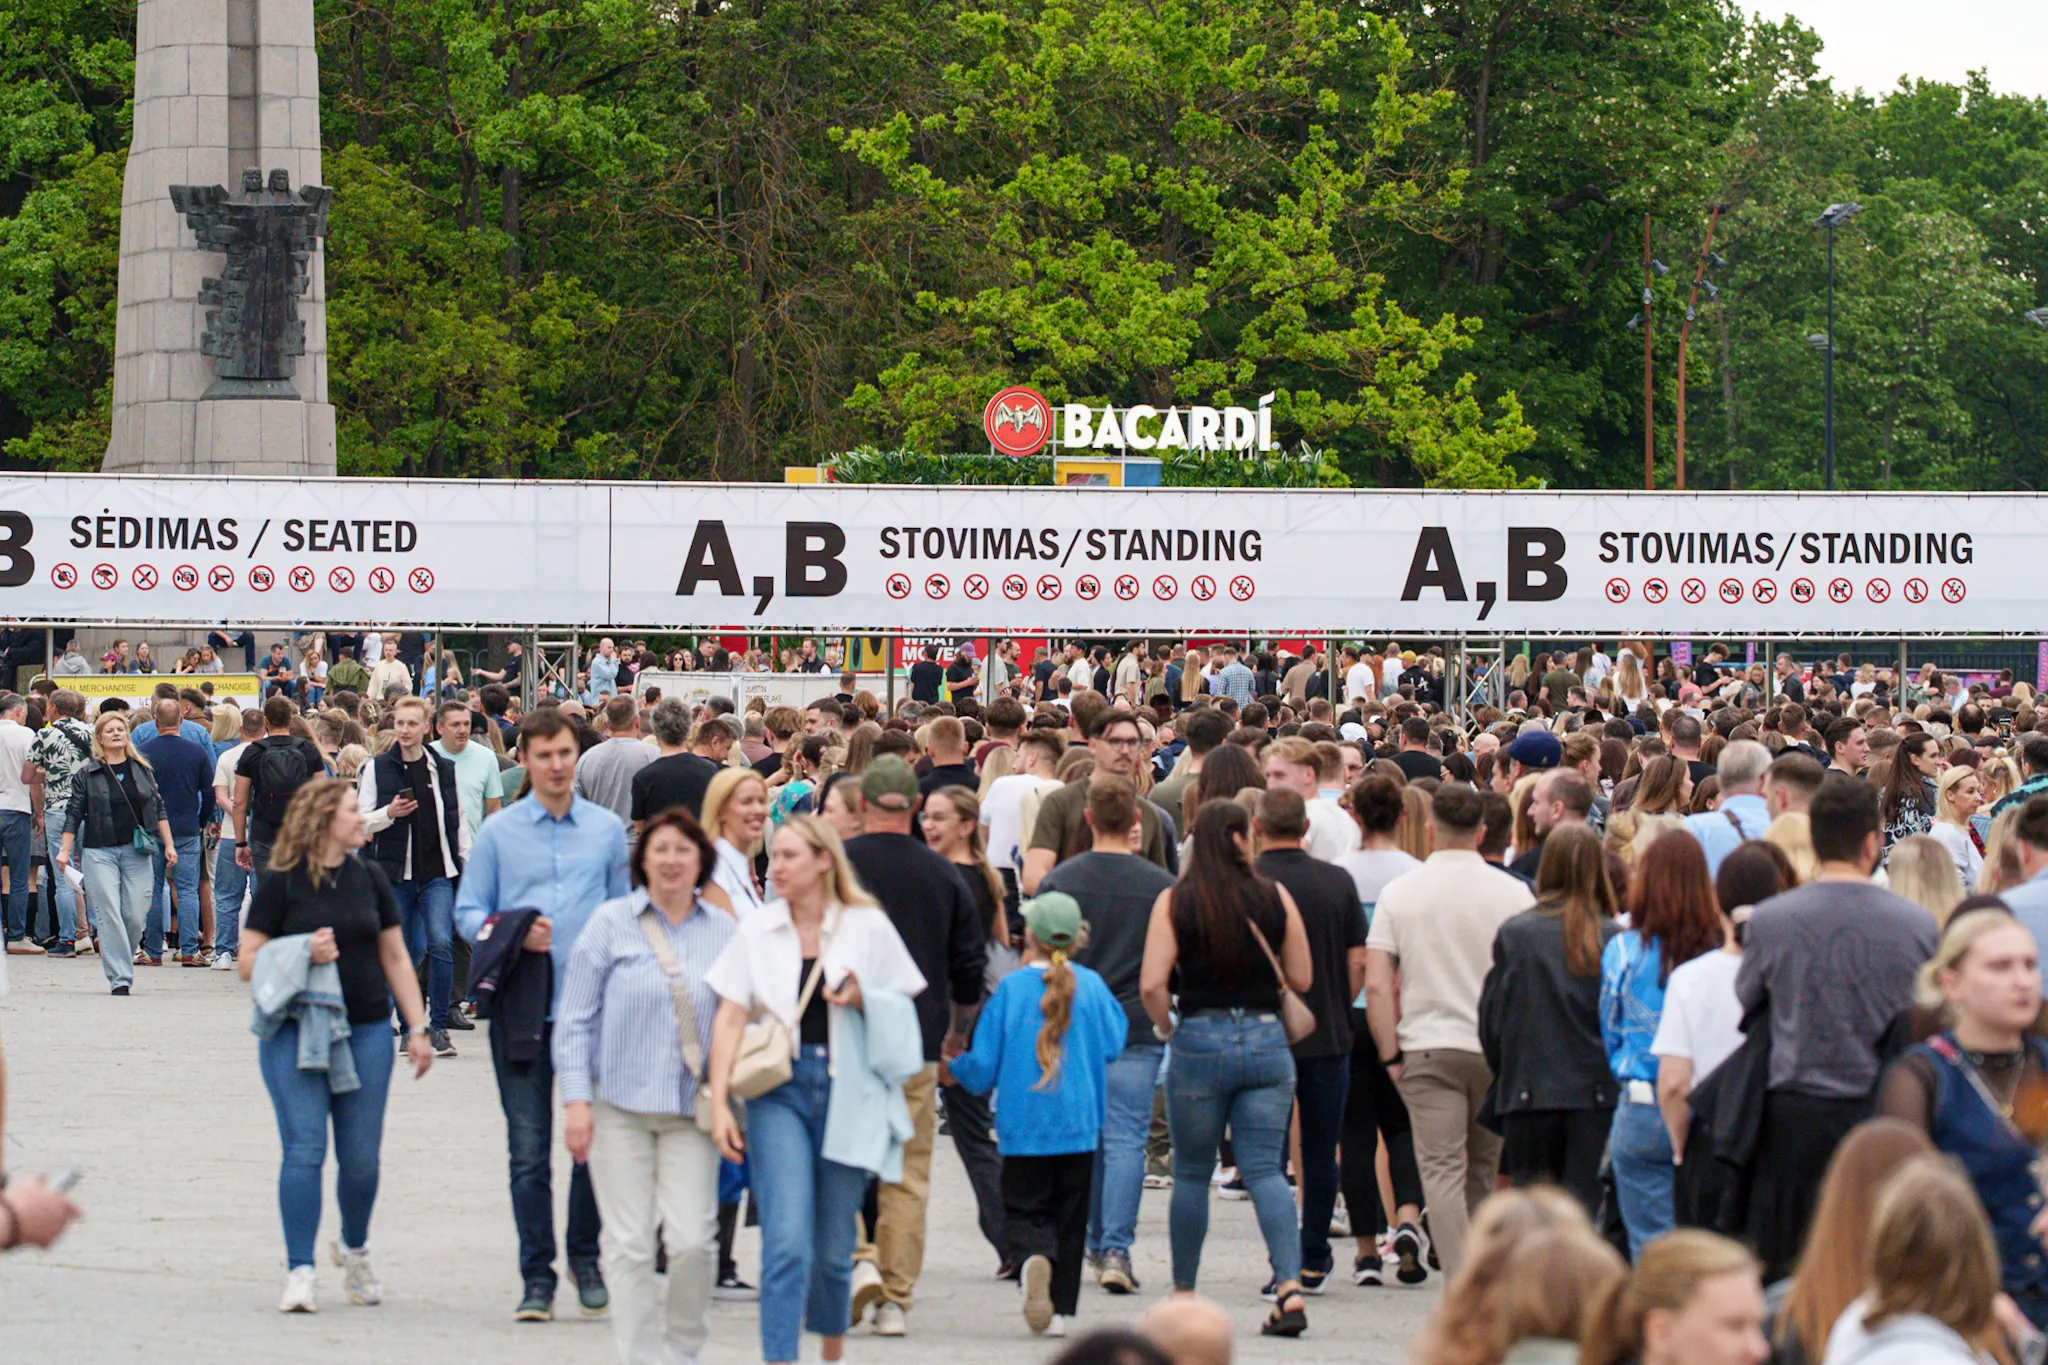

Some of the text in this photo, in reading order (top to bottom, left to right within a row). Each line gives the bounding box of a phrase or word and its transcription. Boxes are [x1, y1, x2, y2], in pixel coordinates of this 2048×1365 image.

[1064, 391, 1275, 451] BACARDÍ
[70, 508, 239, 551] SĖDIMAS
[282, 519, 417, 553] SEATED
[879, 526, 1262, 568] STOVIMAS/STANDING
[1599, 532, 1973, 572] STOVIMAS/STANDING
[675, 519, 848, 616] A,B
[1400, 526, 1568, 621] A,B
[79, 684, 137, 692] MERCHANDISE
[196, 682, 253, 691] MCHANDISE
